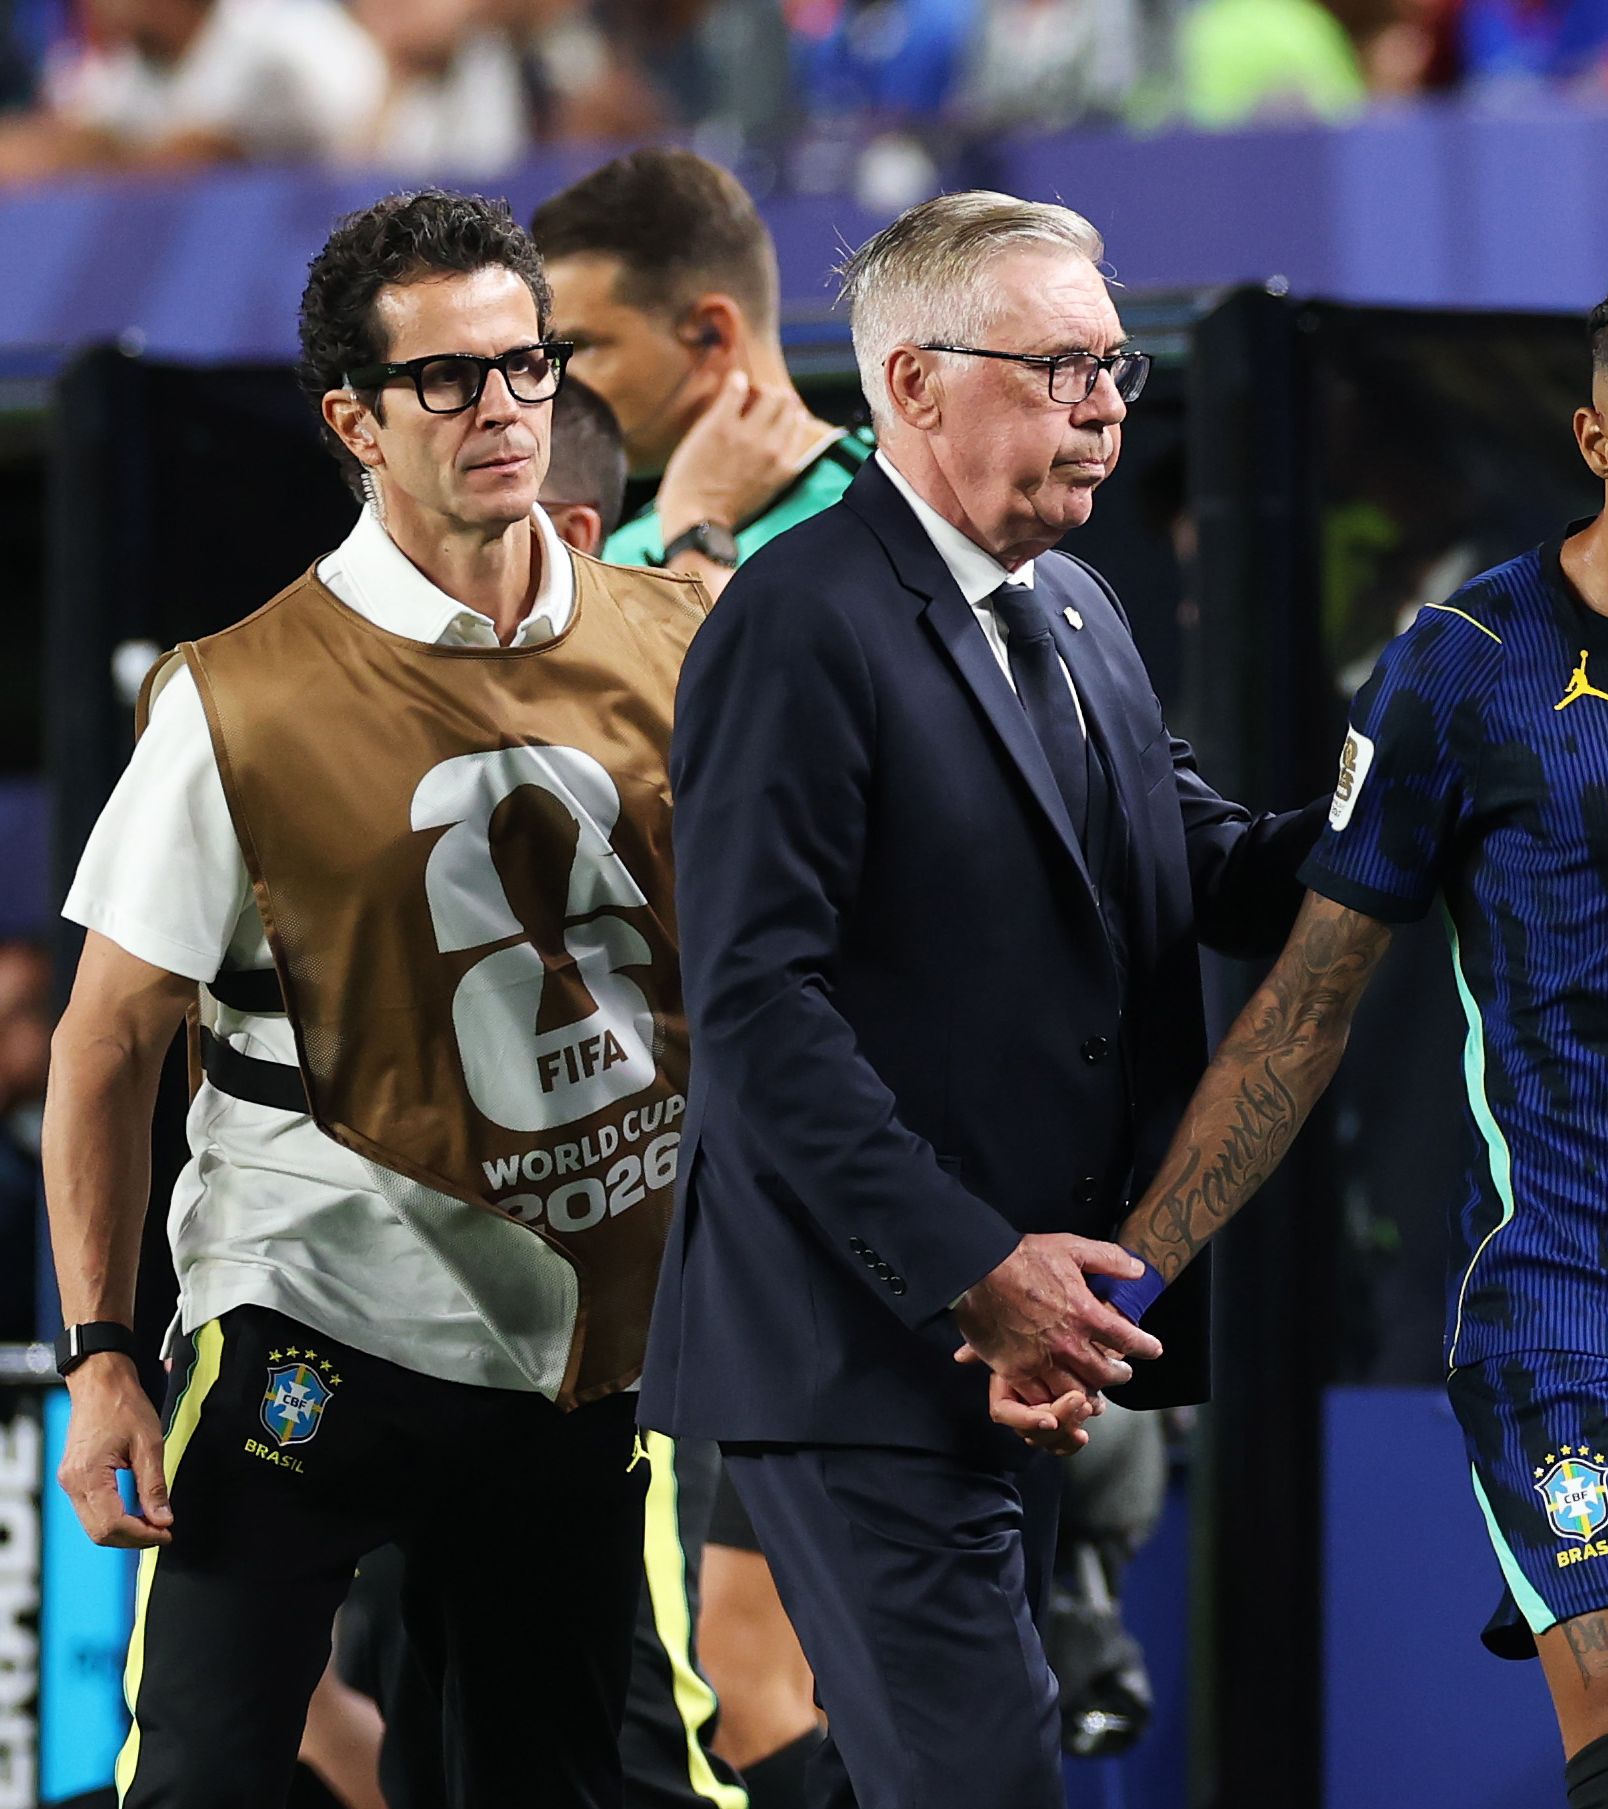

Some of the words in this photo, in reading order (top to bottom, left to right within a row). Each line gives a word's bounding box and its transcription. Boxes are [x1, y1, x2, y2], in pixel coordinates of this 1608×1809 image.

[537, 1028, 629, 1094] FIFA
[482, 1125, 619, 1191] WORLD
[622, 1094, 686, 1142] CUP
[283, 1394, 307, 1410] CBF
[244, 1438, 304, 1474] BRASIL
[1564, 1490, 1588, 1504] CBF
